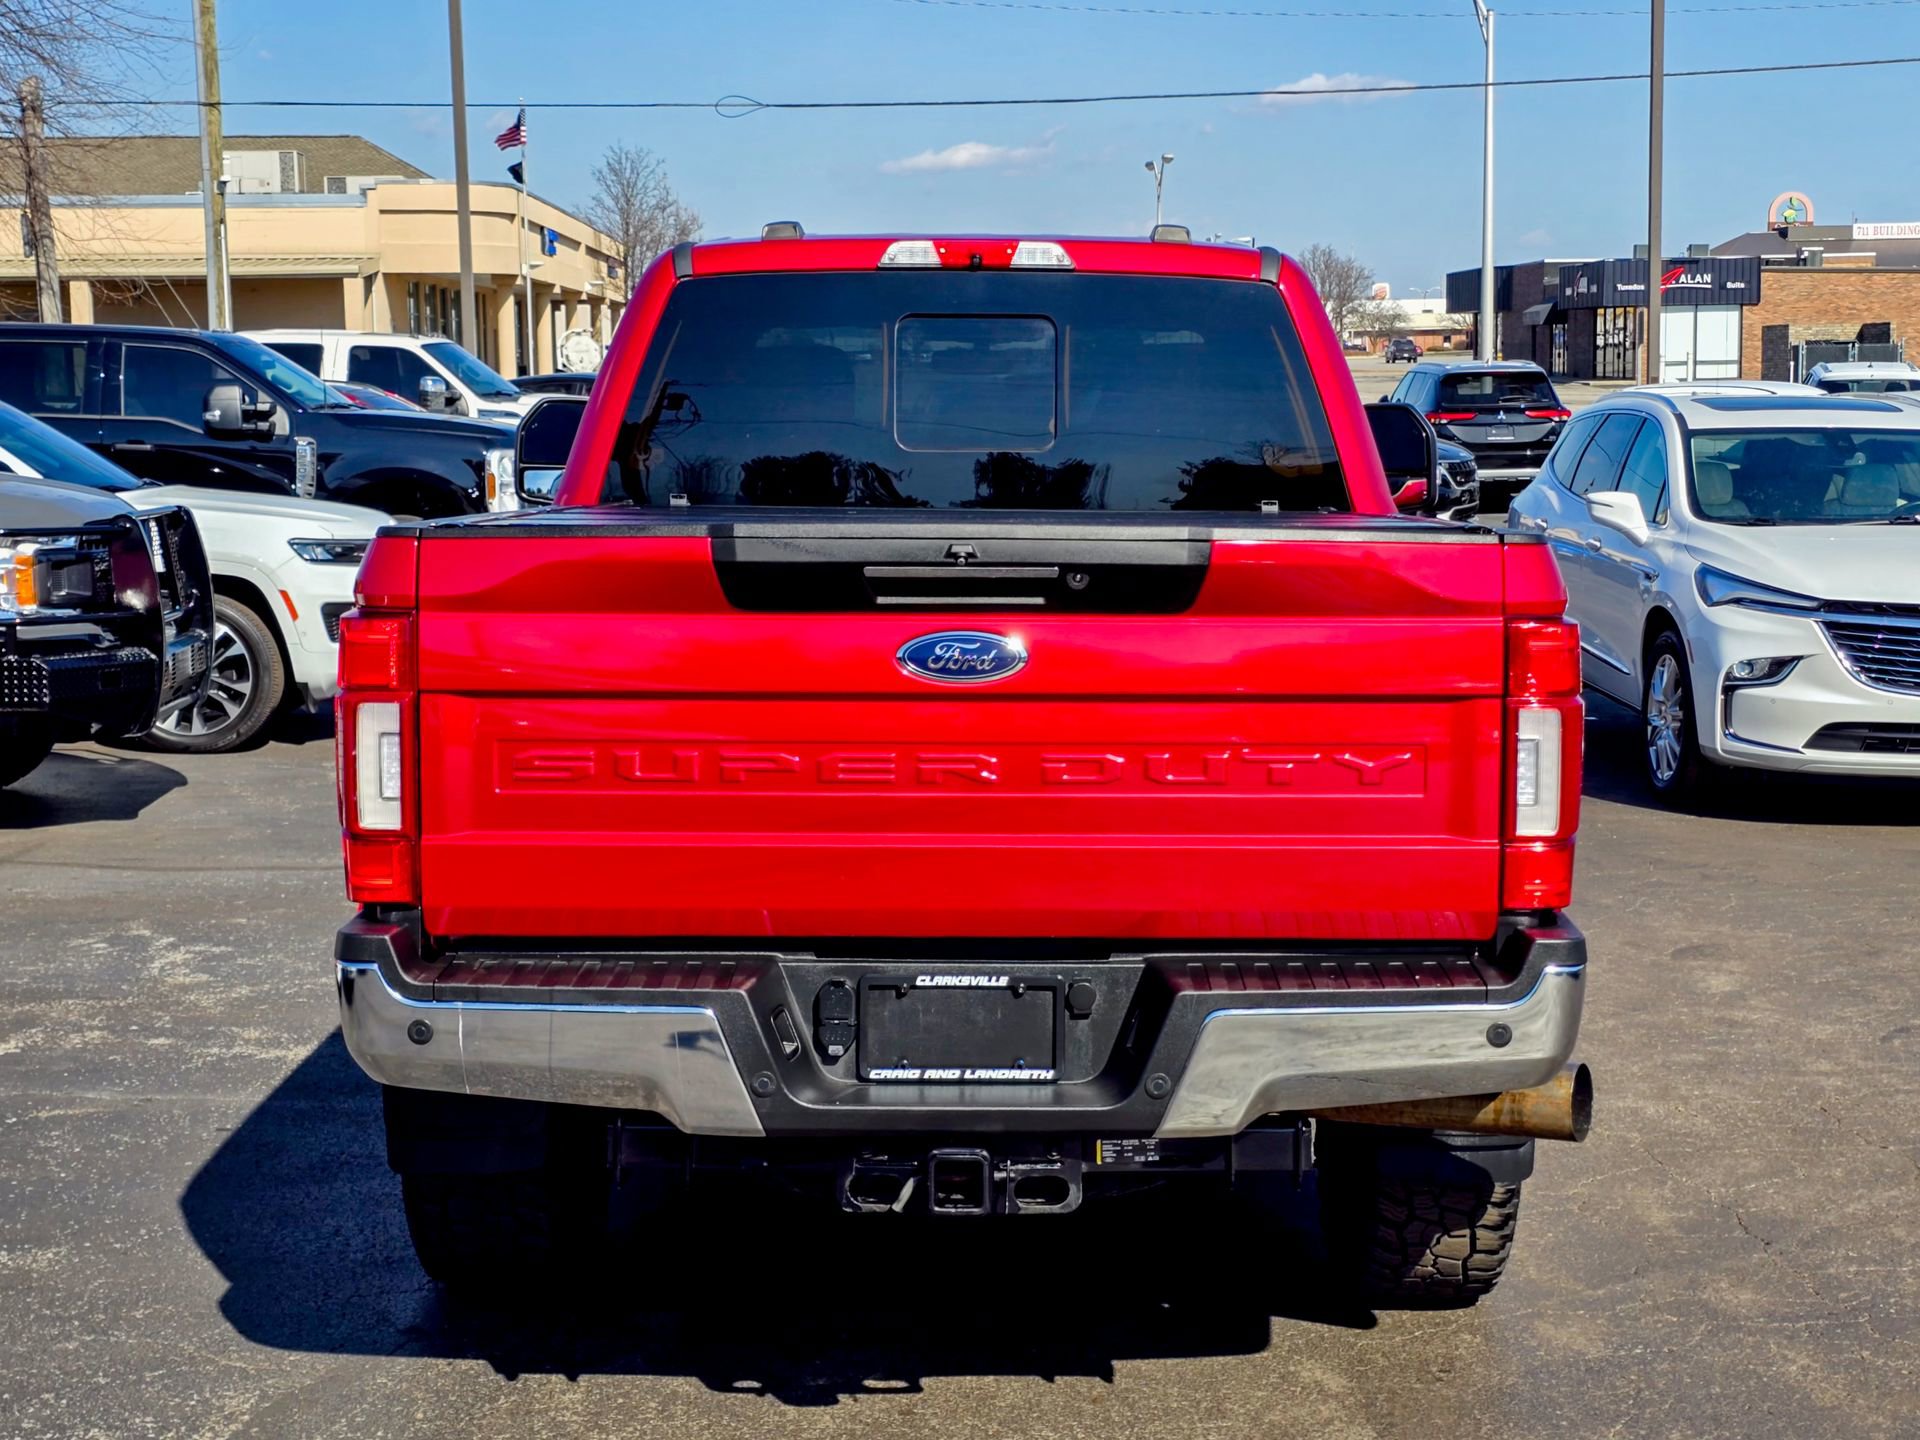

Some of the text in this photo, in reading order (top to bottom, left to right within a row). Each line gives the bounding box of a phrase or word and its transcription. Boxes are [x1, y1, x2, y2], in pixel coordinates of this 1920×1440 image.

[1679, 274, 1711, 284] ALAN
[927, 641, 998, 670] Ford
[512, 749, 1412, 786] SUPER DUTY
[915, 975, 1009, 986] CLARKSVILLE
[923, 1069, 961, 1079] AND
[963, 1069, 1055, 1079] LANDRETH
